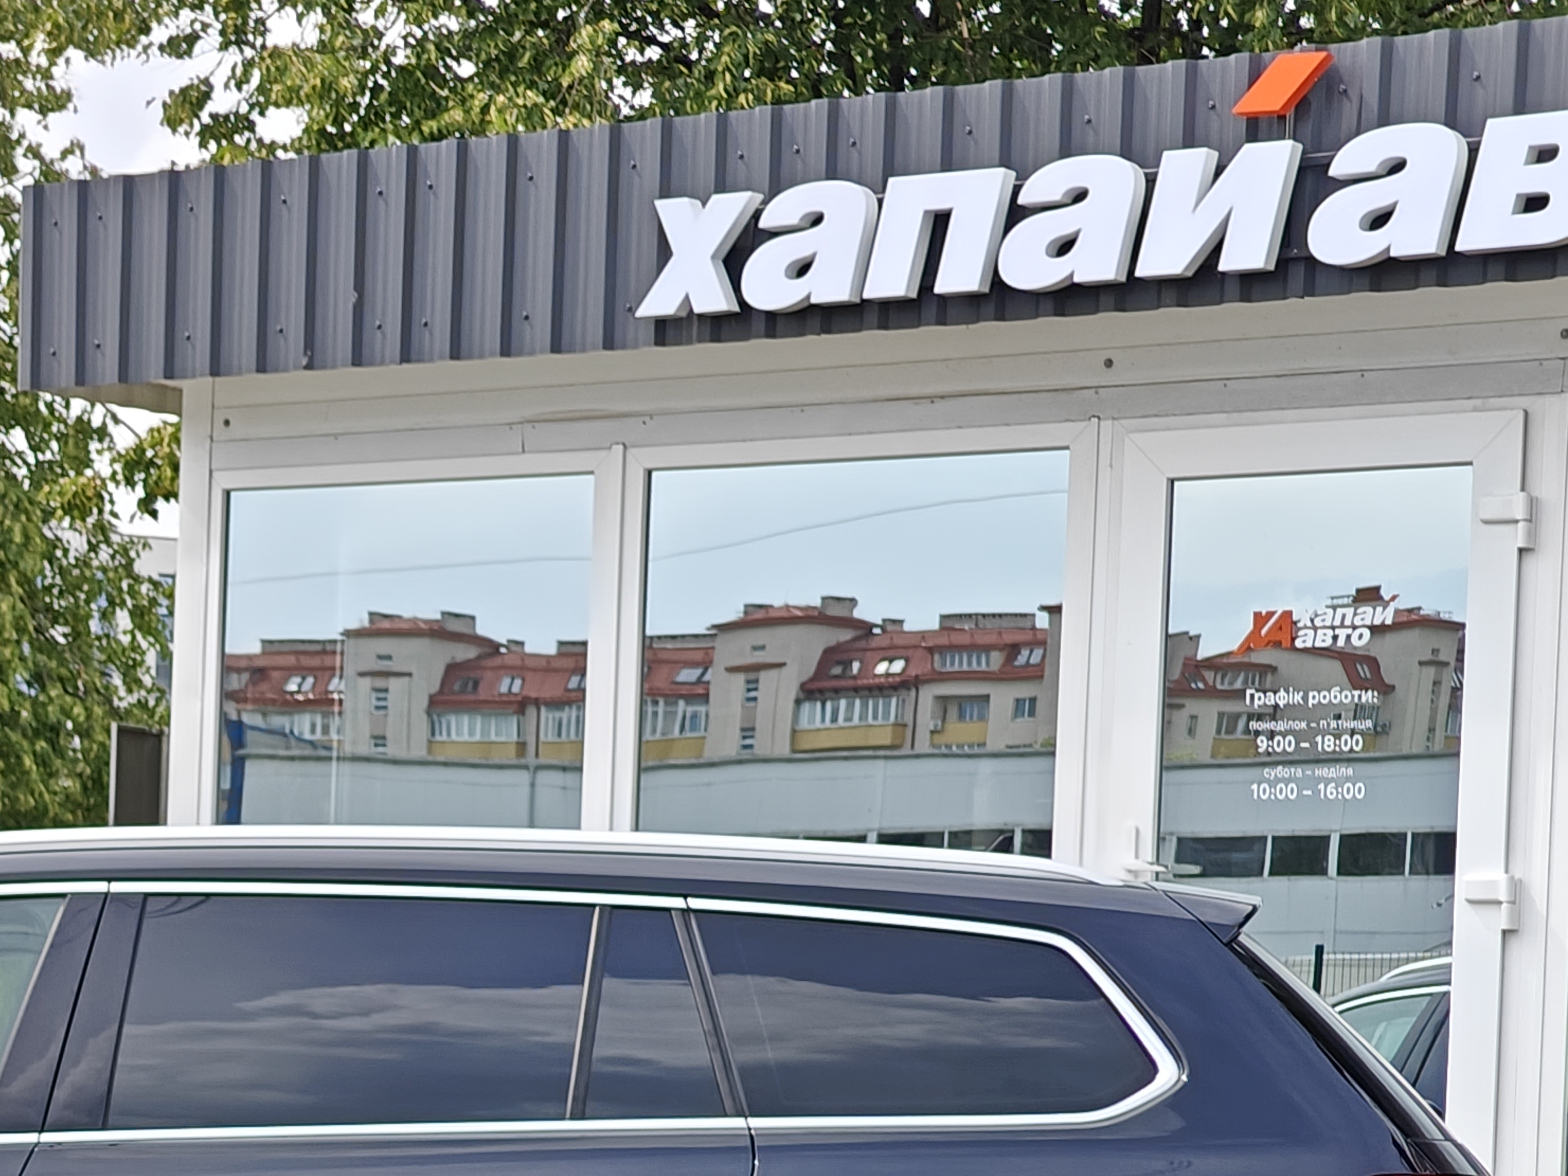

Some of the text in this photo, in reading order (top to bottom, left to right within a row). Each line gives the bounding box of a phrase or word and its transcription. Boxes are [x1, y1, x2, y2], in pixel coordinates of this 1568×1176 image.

[634, 50, 1334, 319] хапай
[1296, 594, 1399, 628] хапай
[1294, 626, 1371, 649] авто
[1245, 686, 1378, 709] Графік роботи:
[1248, 718, 1308, 732] понеділок
[1256, 735, 1295, 753] 9:00
[1315, 734, 1363, 752] 18:00
[1263, 765, 1302, 780] субота
[1315, 765, 1354, 779] неділя
[1250, 783, 1298, 800] 10:00
[1318, 783, 1366, 800] 16:00
